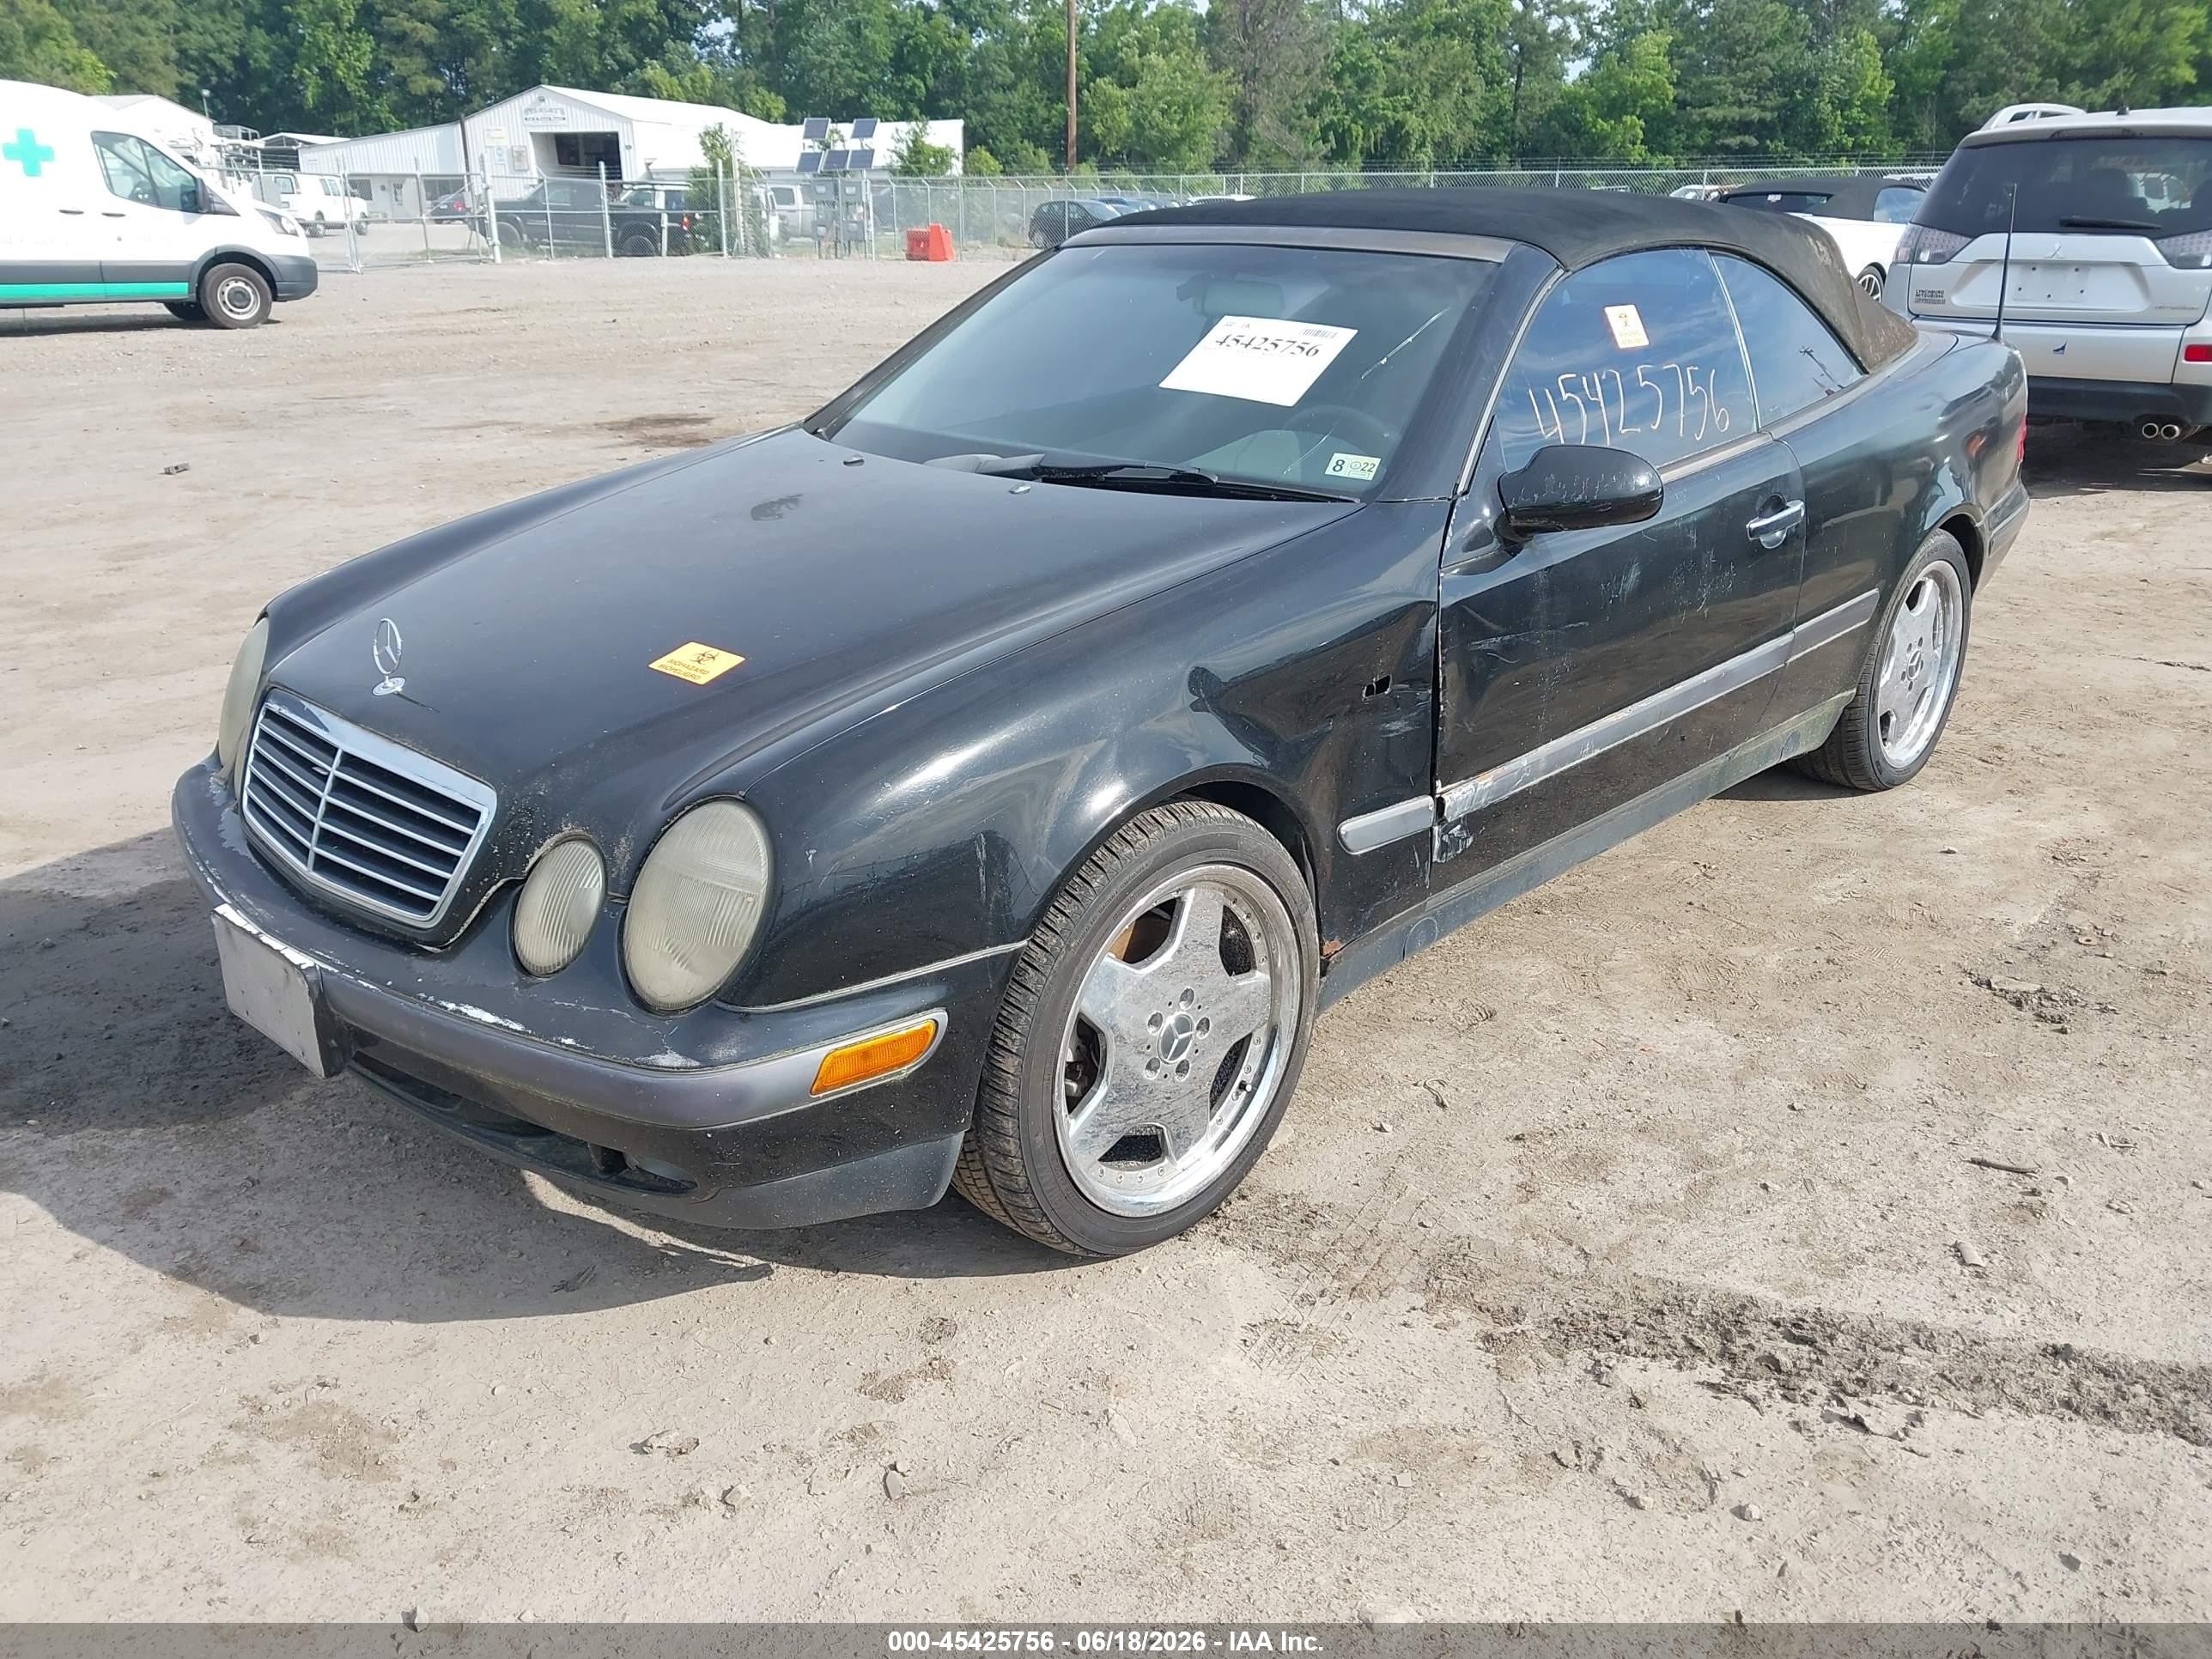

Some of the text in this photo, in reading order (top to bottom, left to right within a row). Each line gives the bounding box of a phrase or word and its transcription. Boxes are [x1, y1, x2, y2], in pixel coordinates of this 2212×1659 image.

[1215, 333, 1324, 357] 45425756
[1528, 363, 1730, 446] 45425756
[1332, 459, 1376, 472] 8 22
[666, 659, 710, 675] BIOHAZARD
